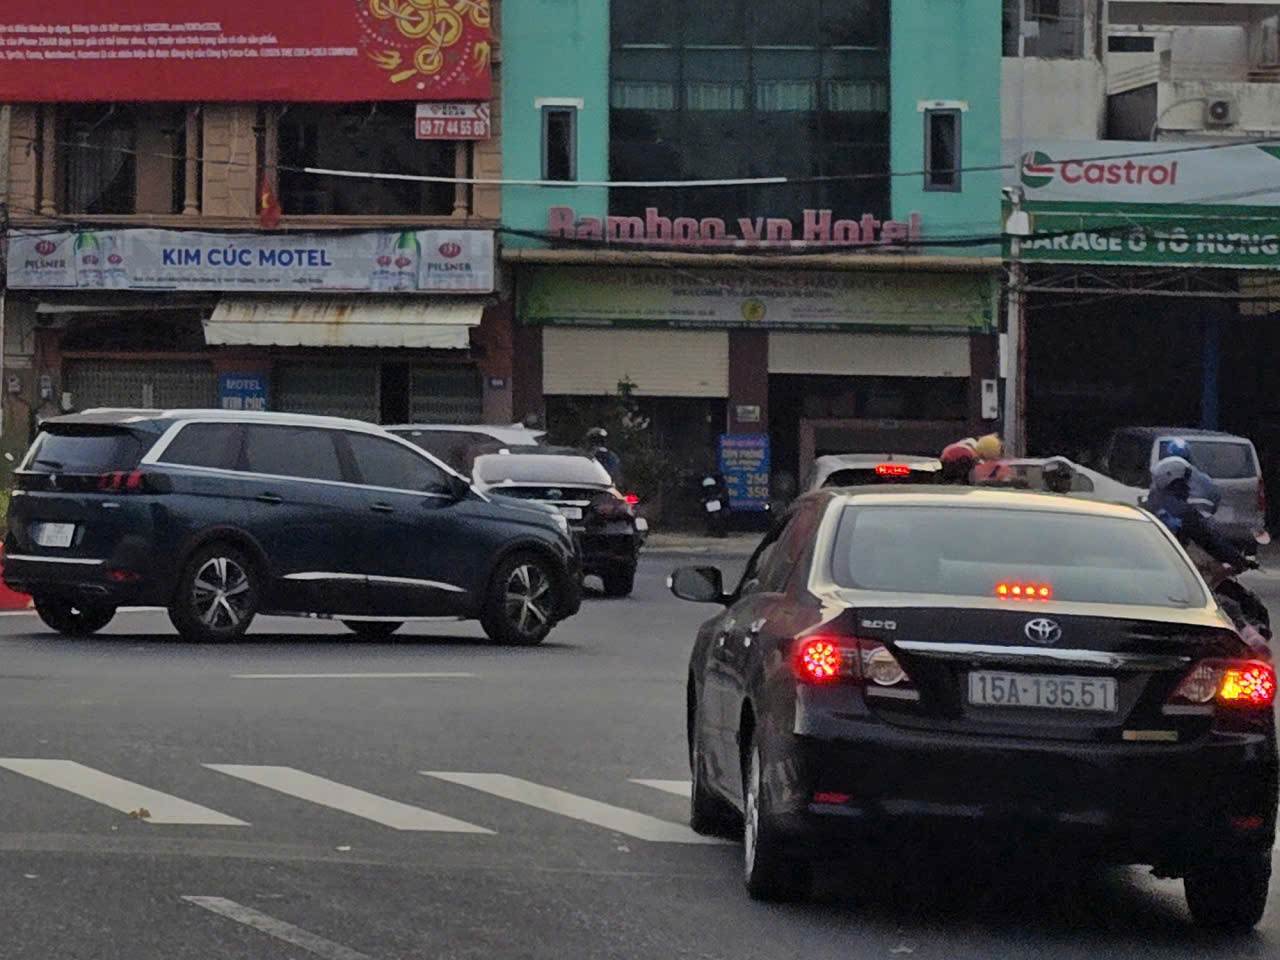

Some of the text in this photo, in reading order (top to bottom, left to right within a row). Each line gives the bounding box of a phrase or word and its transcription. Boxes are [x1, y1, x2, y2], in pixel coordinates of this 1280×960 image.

[1060, 159, 1178, 185] Castrol
[162, 244, 332, 267] KIM CÚC MOTEL
[978, 675, 1109, 711] 15A-135.51
